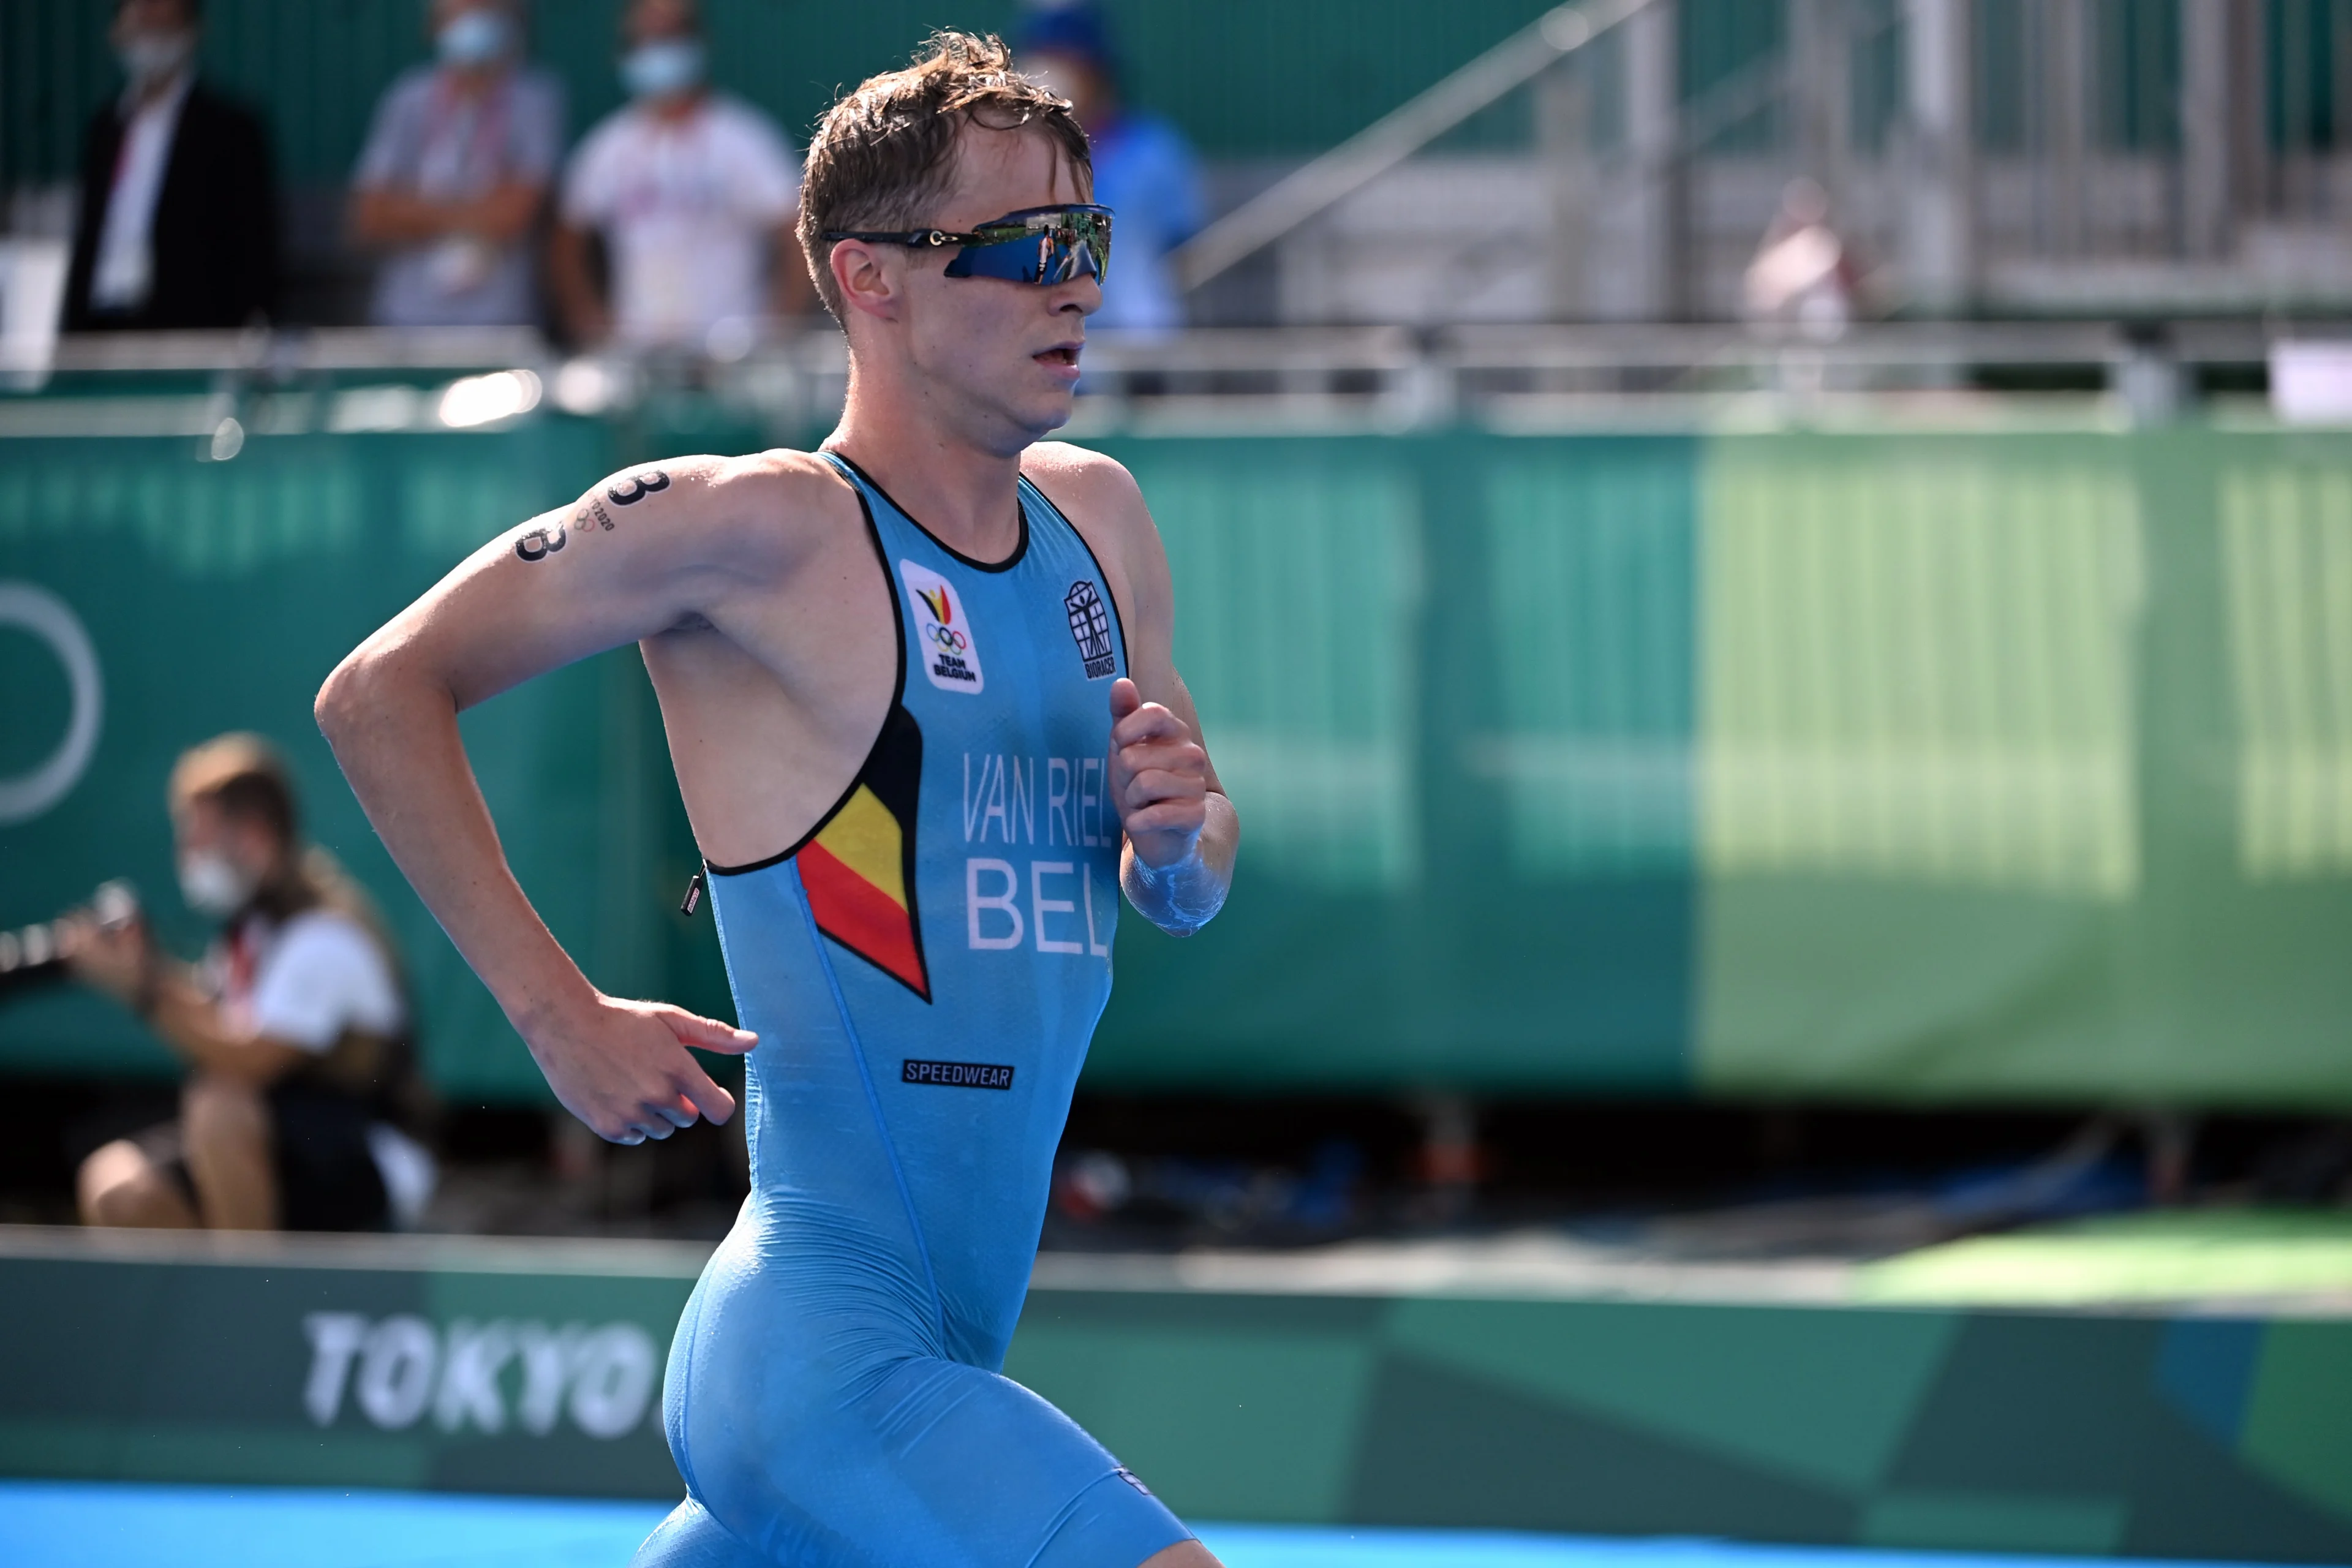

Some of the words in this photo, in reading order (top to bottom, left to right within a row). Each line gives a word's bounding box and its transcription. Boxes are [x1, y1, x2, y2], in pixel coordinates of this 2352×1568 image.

[933, 664, 976, 682] BELGIUM
[938, 653, 966, 669] TEAM
[1085, 656, 1116, 679] BIORACER
[963, 753, 1034, 845] VAN
[1048, 758, 1111, 847] RIEL
[967, 858, 1107, 957] BEL
[906, 1063, 1010, 1087] SPEEDWEAR
[304, 1311, 657, 1439] TOKYO
